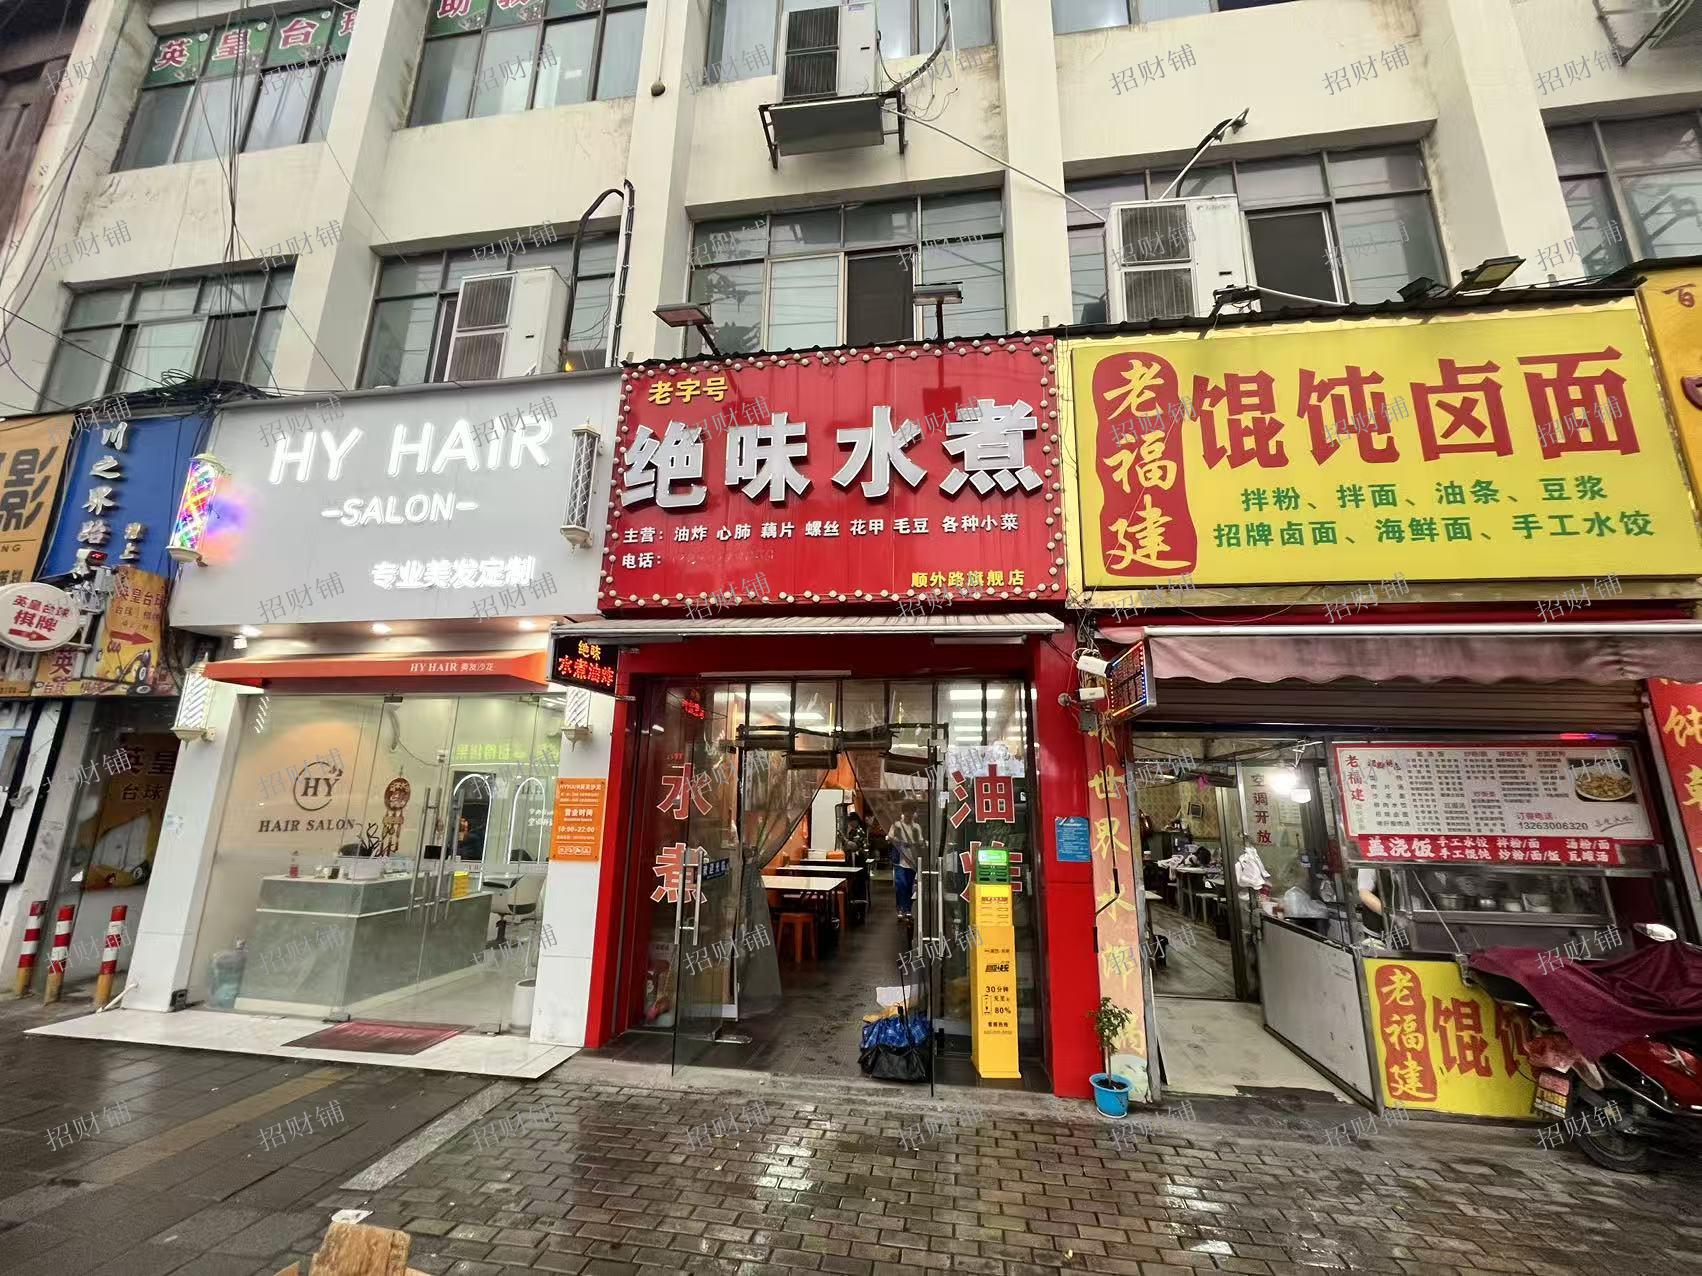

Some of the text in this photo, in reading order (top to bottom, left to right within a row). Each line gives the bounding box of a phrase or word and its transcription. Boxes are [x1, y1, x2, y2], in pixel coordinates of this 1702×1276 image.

[647, 375, 729, 405] 老字号
[1192, 346, 1641, 470] 馄饨卤面
[268, 415, 554, 486] HY HAIR
[620, 398, 1044, 509] 绝味水煮
[1102, 358, 1191, 571] 老福建
[0, 446, 58, 532] 影
[1239, 474, 1609, 513] 拌粉、拌面、油条、豆浆
[673, 525, 707, 543] 油炸
[716, 523, 751, 541] 心肺
[761, 521, 794, 539] 藕片
[805, 519, 840, 538] 螺丝
[850, 518, 885, 536] 花甲
[893, 516, 930, 535] 毛豆
[941, 512, 1020, 533] 各种小菜
[1212, 509, 1657, 549] 招牌卤面、海鲜面、手工水饺
[370, 554, 537, 590] 专业美发定制
[911, 568, 1025, 590] 顺外路旗舰店
[12, 594, 70, 618] 英皇台球
[410, 662, 458, 672] HY HAIR
[300, 777, 341, 797] HY
[1250, 774, 1272, 844] 空调开放
[258, 819, 356, 833] HAIR SALON
[1437, 835, 1489, 848] 手工水饺
[1518, 821, 1588, 831] 13263006320
[1366, 835, 1436, 858] 盖浇饭
[994, 1006, 1011, 1014] 80%
[1380, 968, 1434, 1099] 老福建
